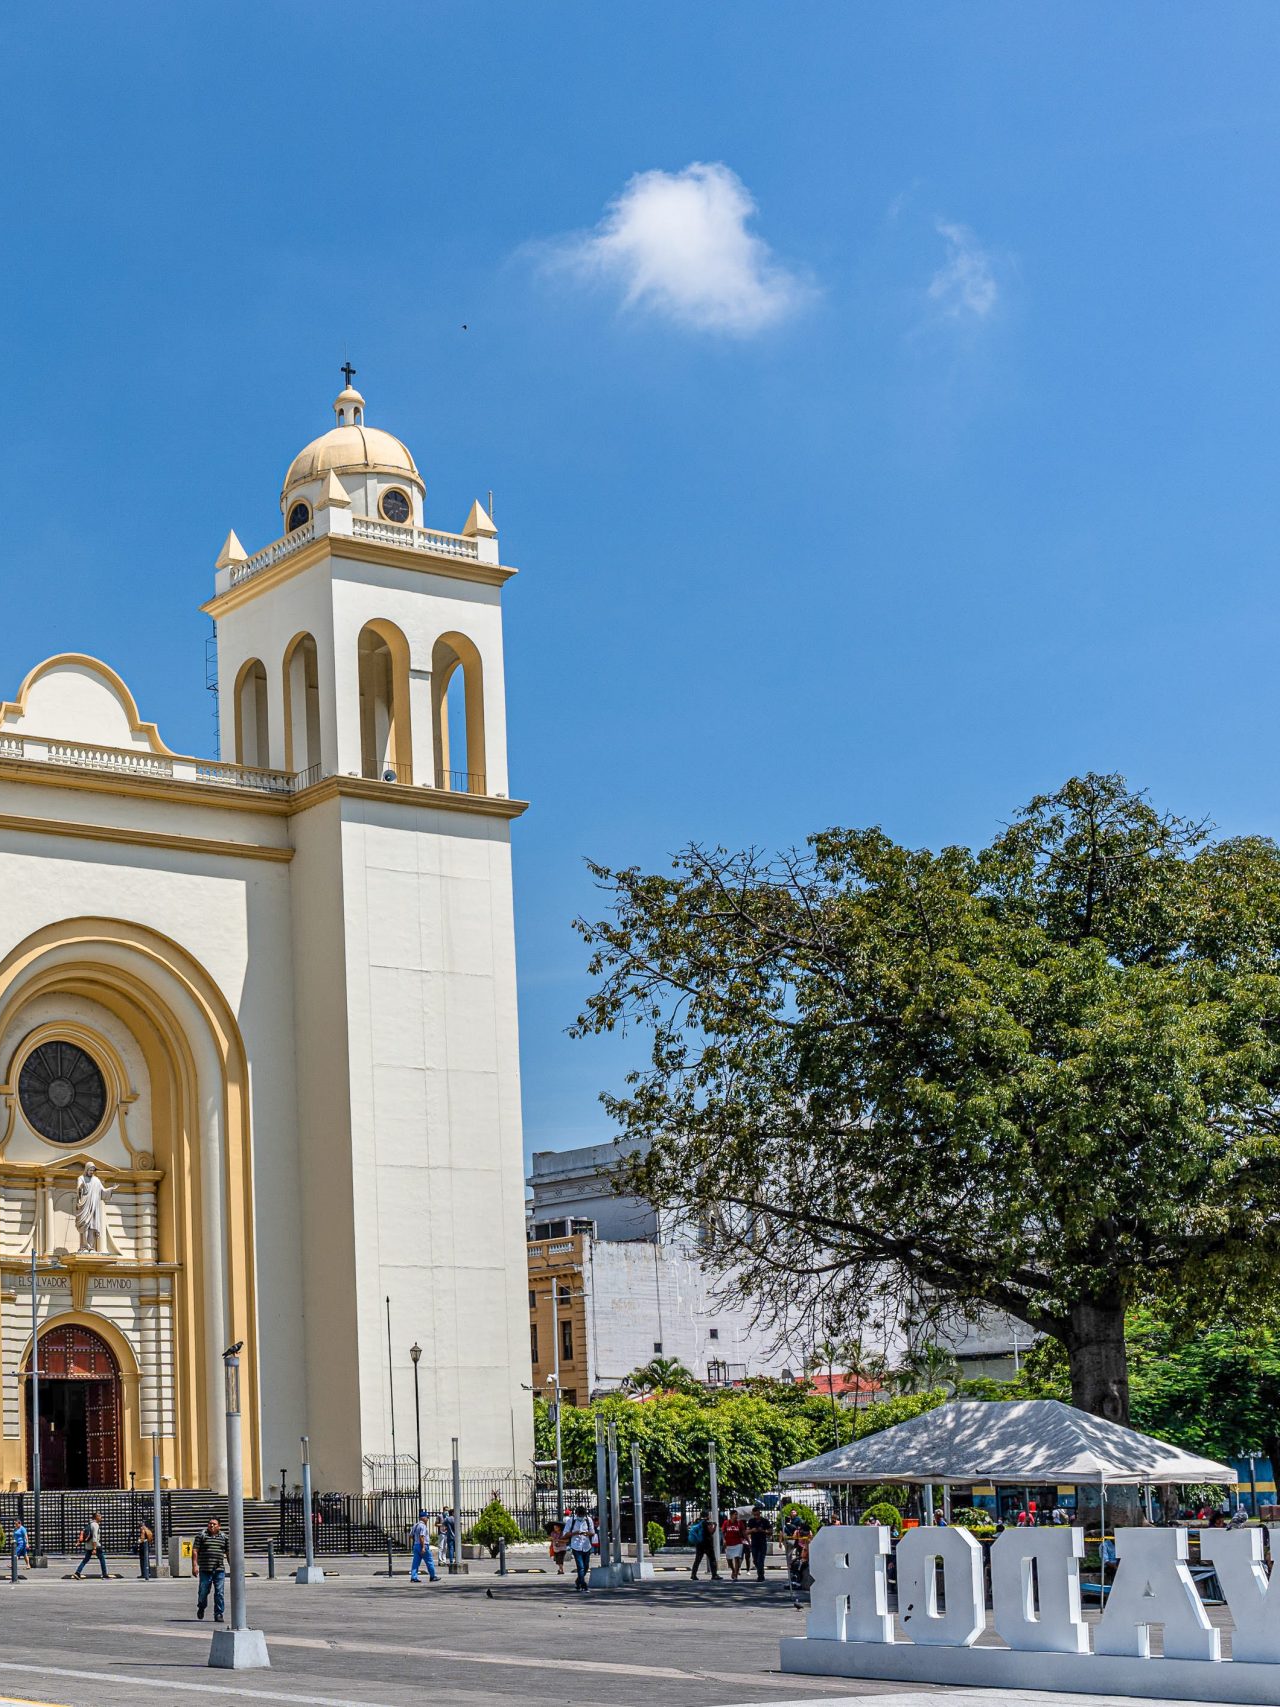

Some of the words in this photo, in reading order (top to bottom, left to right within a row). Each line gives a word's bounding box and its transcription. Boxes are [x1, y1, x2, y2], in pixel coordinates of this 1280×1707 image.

[19, 1276, 26, 1287] EL
[26, 1276, 67, 1288] SLVADOR
[94, 1278, 106, 1289] DEL
